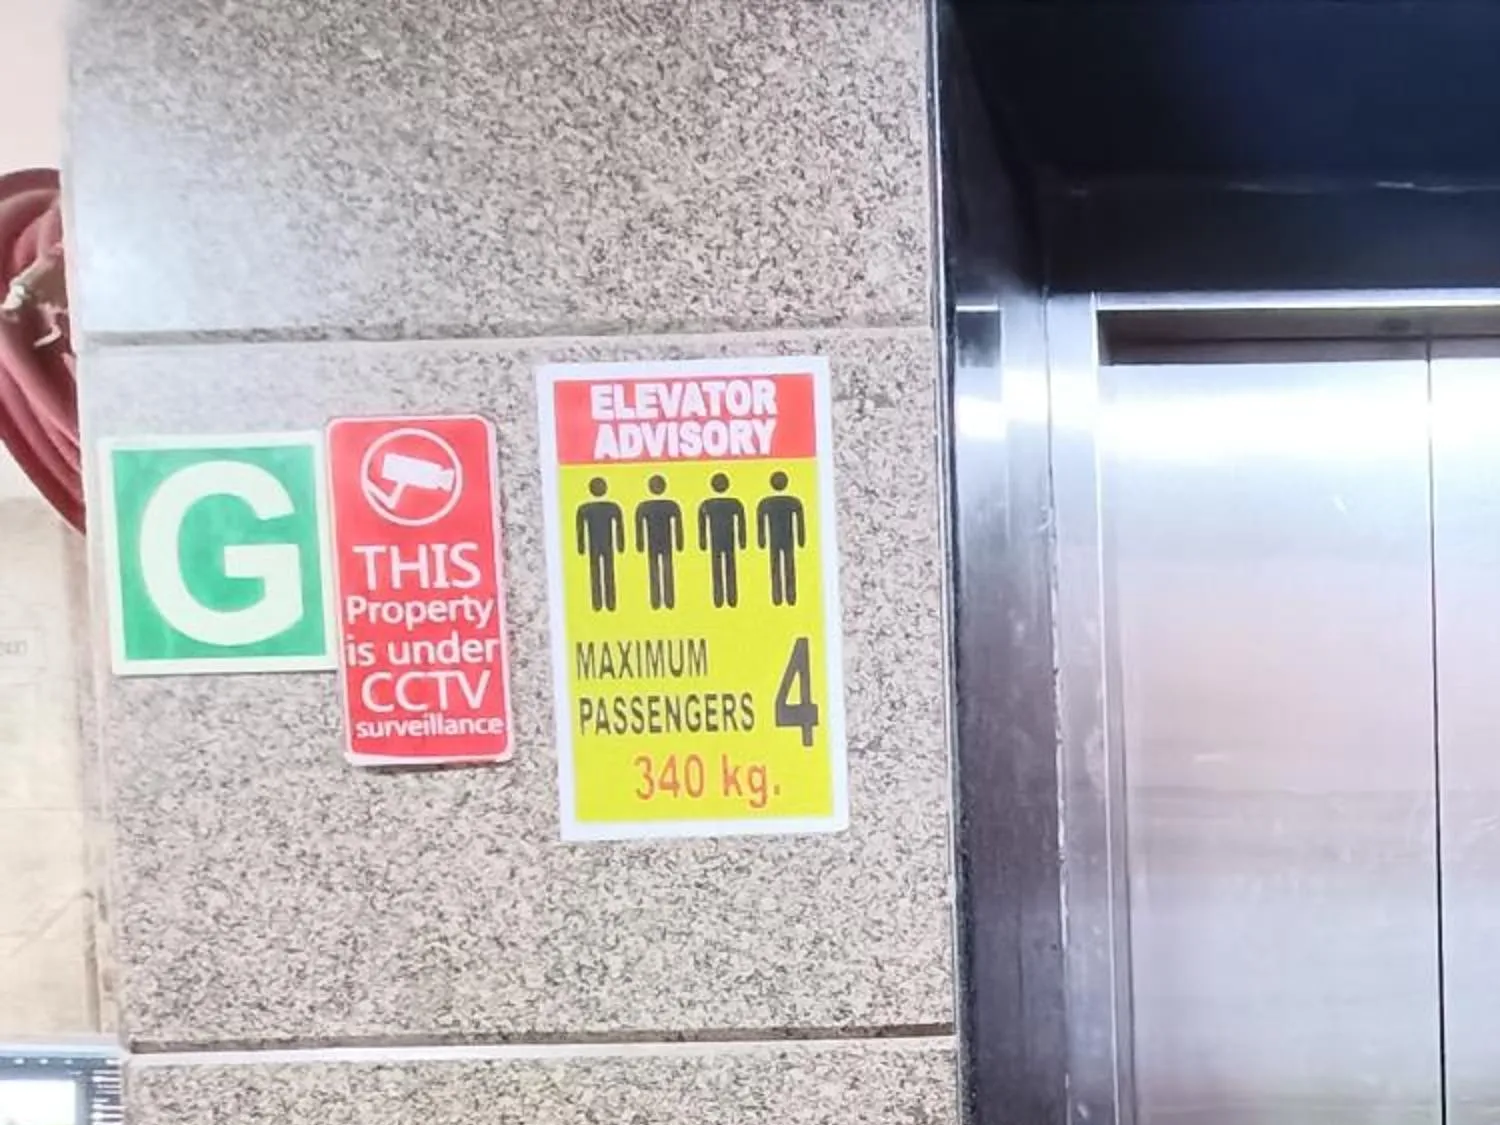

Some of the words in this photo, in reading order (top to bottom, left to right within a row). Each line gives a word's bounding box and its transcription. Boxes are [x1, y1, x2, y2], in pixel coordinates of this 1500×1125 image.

[590, 378, 778, 421] ELEVATOR
[593, 417, 777, 461] ADVISORY
[139, 460, 304, 646] G
[352, 542, 482, 590] THIS
[347, 595, 495, 630] Property
[346, 637, 375, 668] is
[387, 633, 499, 667] under
[575, 637, 709, 681] MAXIMUM
[360, 669, 491, 714] CCTV
[775, 636, 819, 748] 4
[355, 712, 505, 739] surveillance
[579, 692, 755, 736] PASSENGERS
[632, 753, 706, 801] 340
[721, 753, 781, 809] kg.
